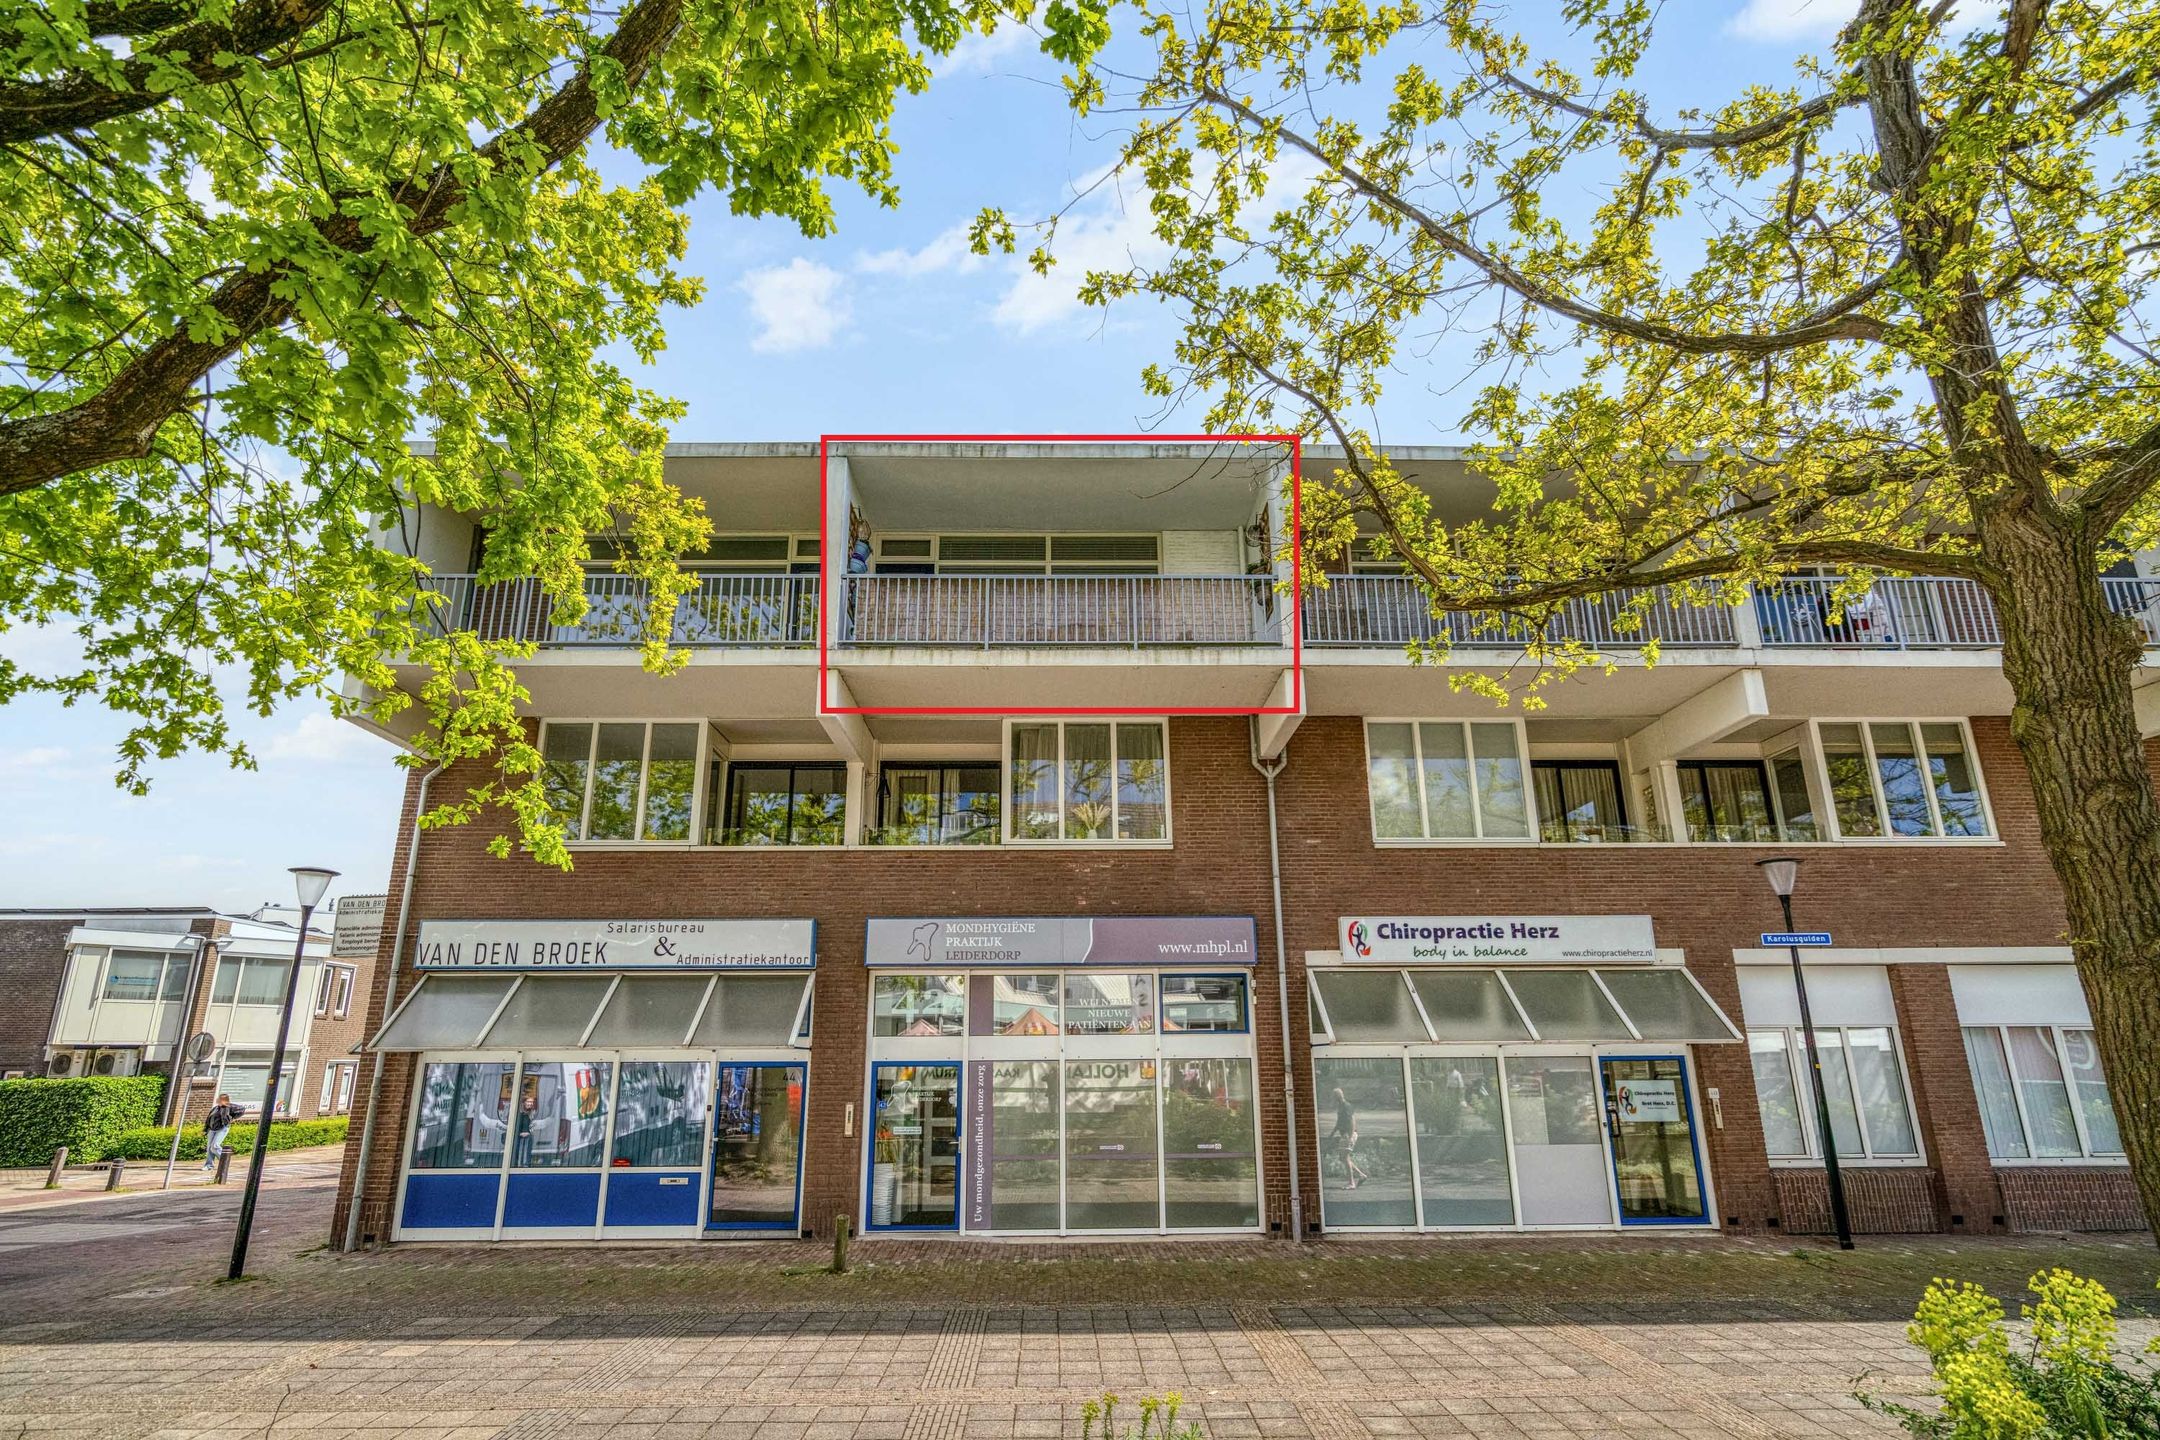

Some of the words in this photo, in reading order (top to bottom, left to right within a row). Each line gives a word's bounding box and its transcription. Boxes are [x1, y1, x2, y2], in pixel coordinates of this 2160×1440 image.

[607, 922, 704, 933] Salarisbureau
[946, 921, 1036, 933] MONDHYGIËNE
[1377, 922, 1505, 944] Chiropractie
[1510, 923, 1559, 939] Herz
[946, 936, 1002, 947] PRAKTIJK
[1766, 935, 1826, 943] Karolusgulden
[654, 936, 676, 957] &
[1158, 940, 1249, 956] www.mhpl.nl
[1413, 945, 1446, 960] body
[1452, 946, 1468, 957] in
[1474, 945, 1528, 957] balance
[419, 942, 461, 966] VAN
[474, 942, 519, 965] DEN
[533, 942, 608, 965] BROEK
[676, 953, 809, 965] Administratiekantoor
[946, 950, 1021, 961] LEIDERDORP
[1561, 949, 1653, 958] www.chiropractieherz.nl
[1088, 1009, 1131, 1017] NIEUWE
[1068, 1019, 1127, 1029] PATIËNTEN
[1129, 1020, 1151, 1029] AAN
[783, 1072, 796, 1081] 44
[977, 1065, 986, 1087] zorg
[974, 1113, 985, 1203] mondgezondheid,
[974, 1205, 983, 1222] Uw
